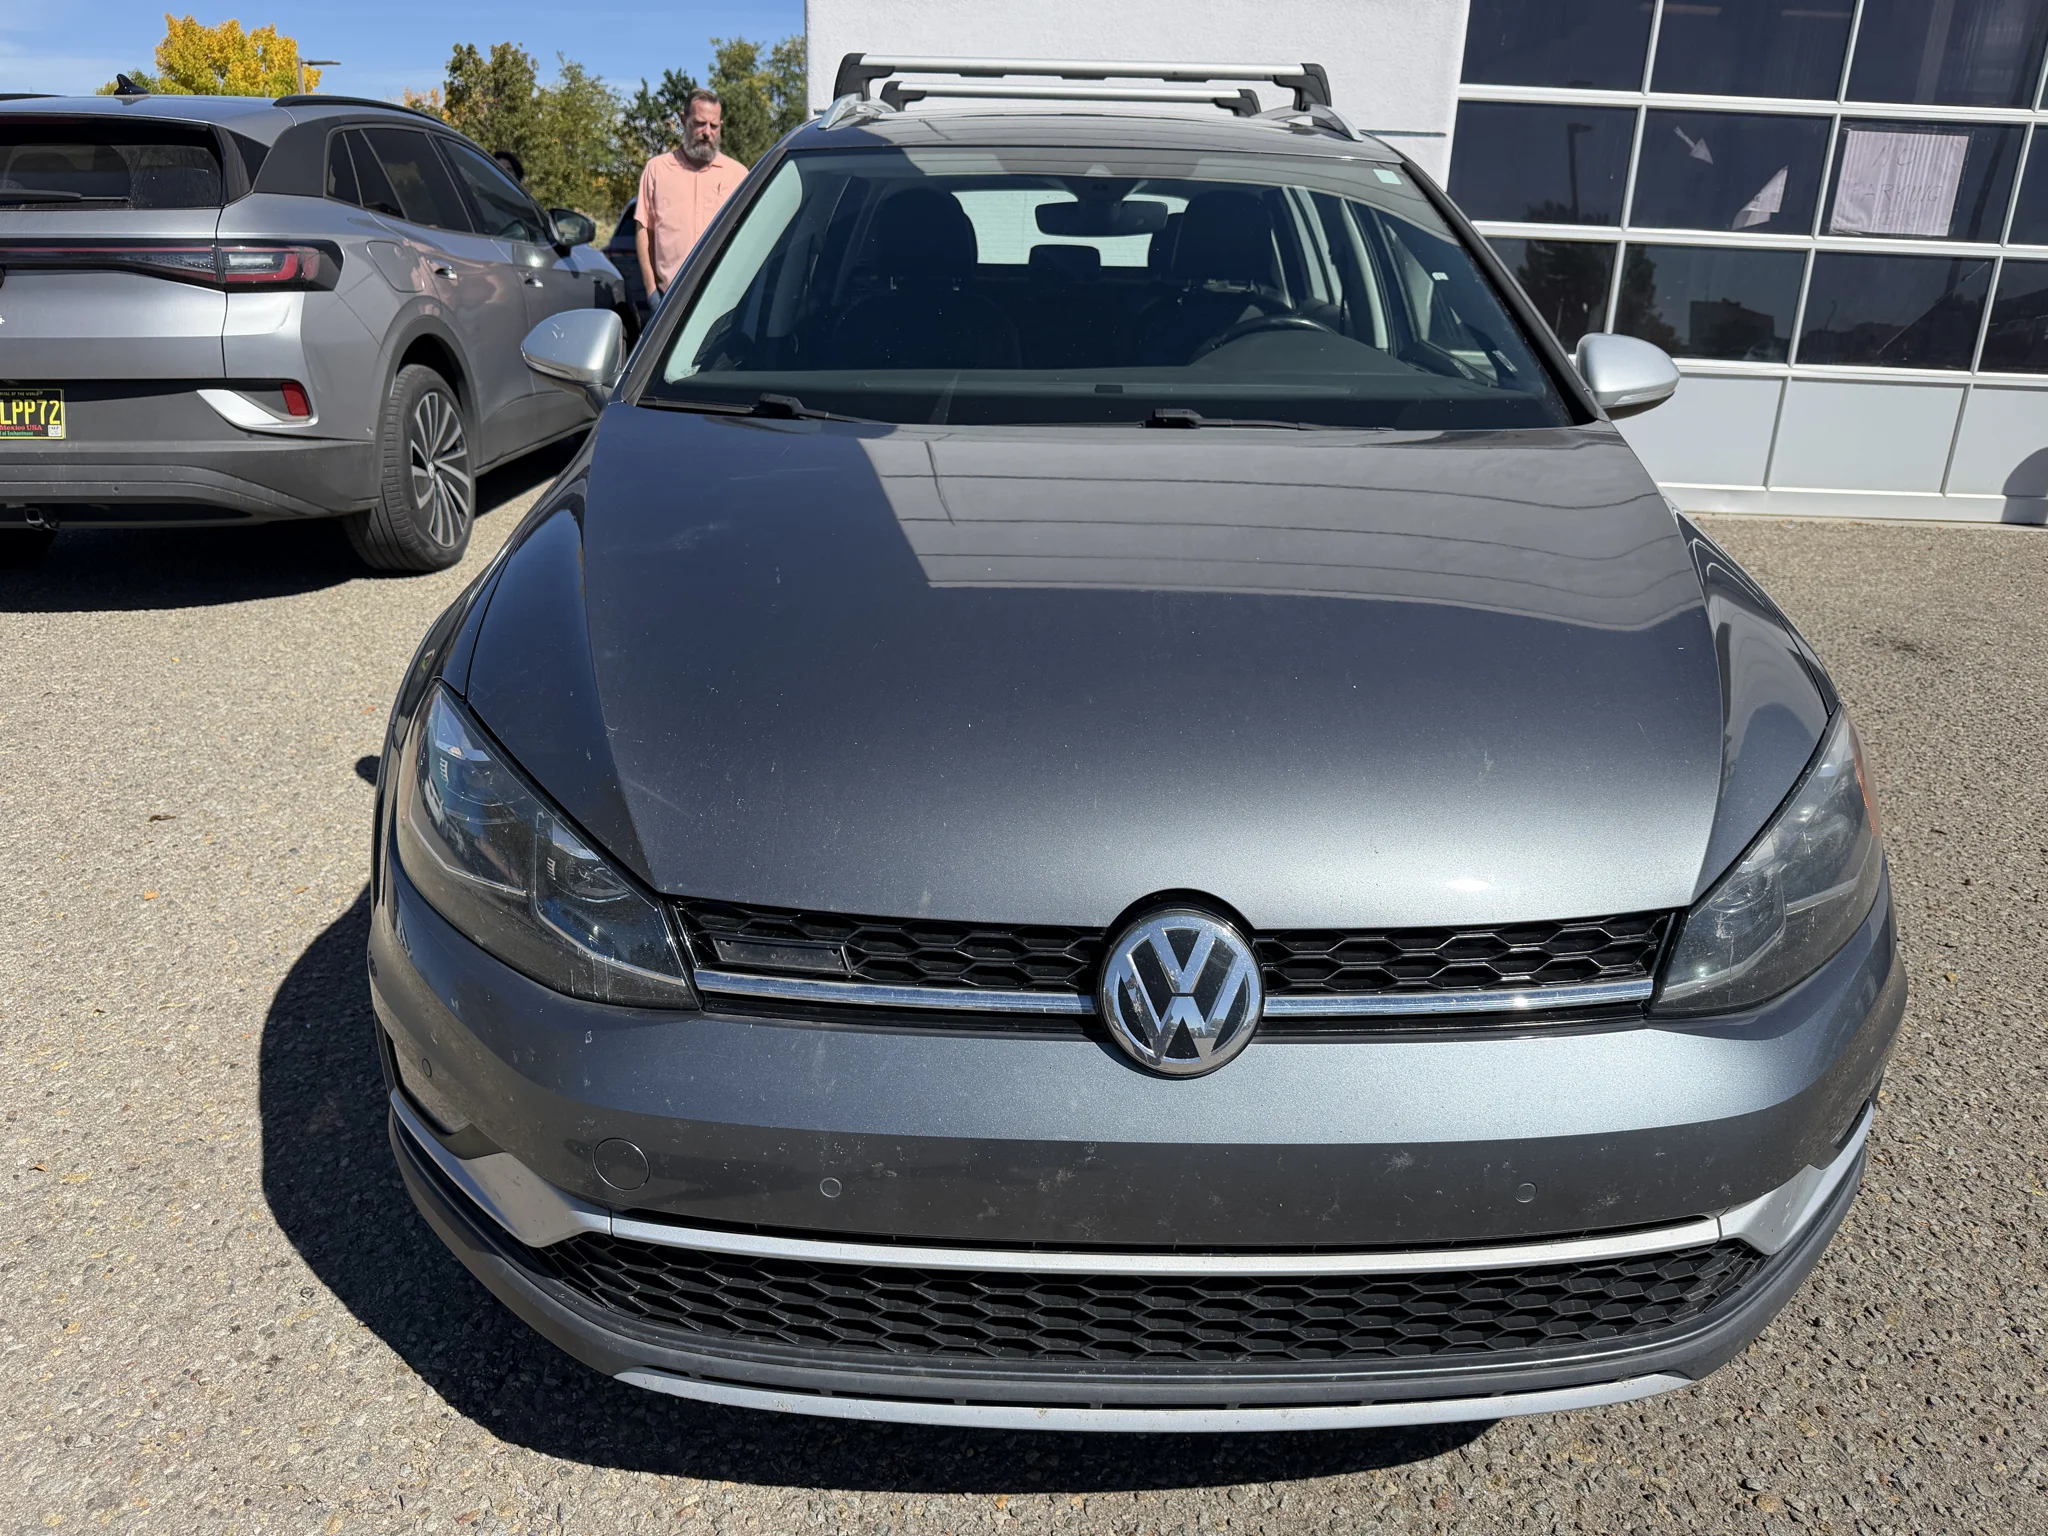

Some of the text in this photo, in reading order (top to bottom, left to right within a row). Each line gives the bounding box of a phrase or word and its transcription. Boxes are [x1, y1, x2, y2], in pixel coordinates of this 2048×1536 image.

[1850, 182, 1943, 204] PARKING
[0, 399, 60, 425] LPP72
[1109, 915, 1255, 1066] VW
